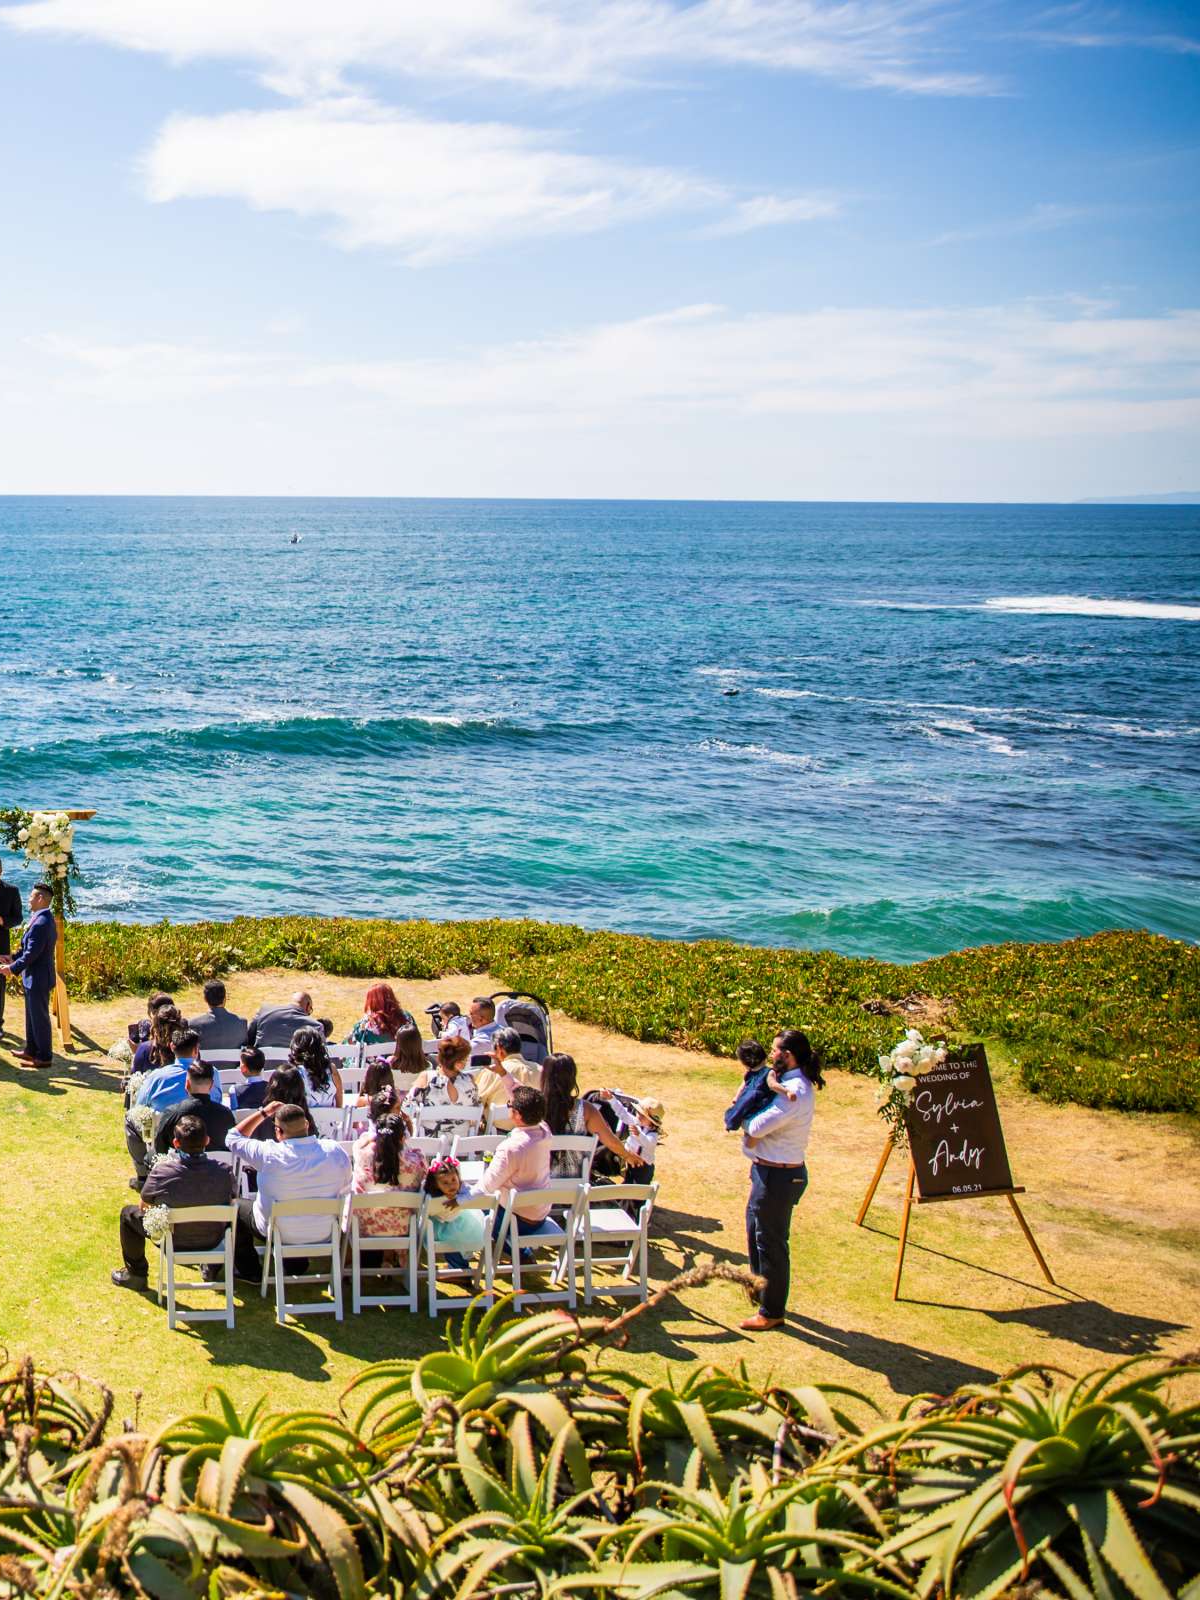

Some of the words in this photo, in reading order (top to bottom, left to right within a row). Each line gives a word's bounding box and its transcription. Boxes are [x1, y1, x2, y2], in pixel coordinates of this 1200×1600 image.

[961, 1060, 977, 1069] THE
[918, 1072, 958, 1083] WEDDING
[959, 1071, 970, 1080] OF
[915, 1090, 984, 1123] Sylvia
[928, 1138, 985, 1176] Andy
[952, 1184, 982, 1194] 06.05.21
